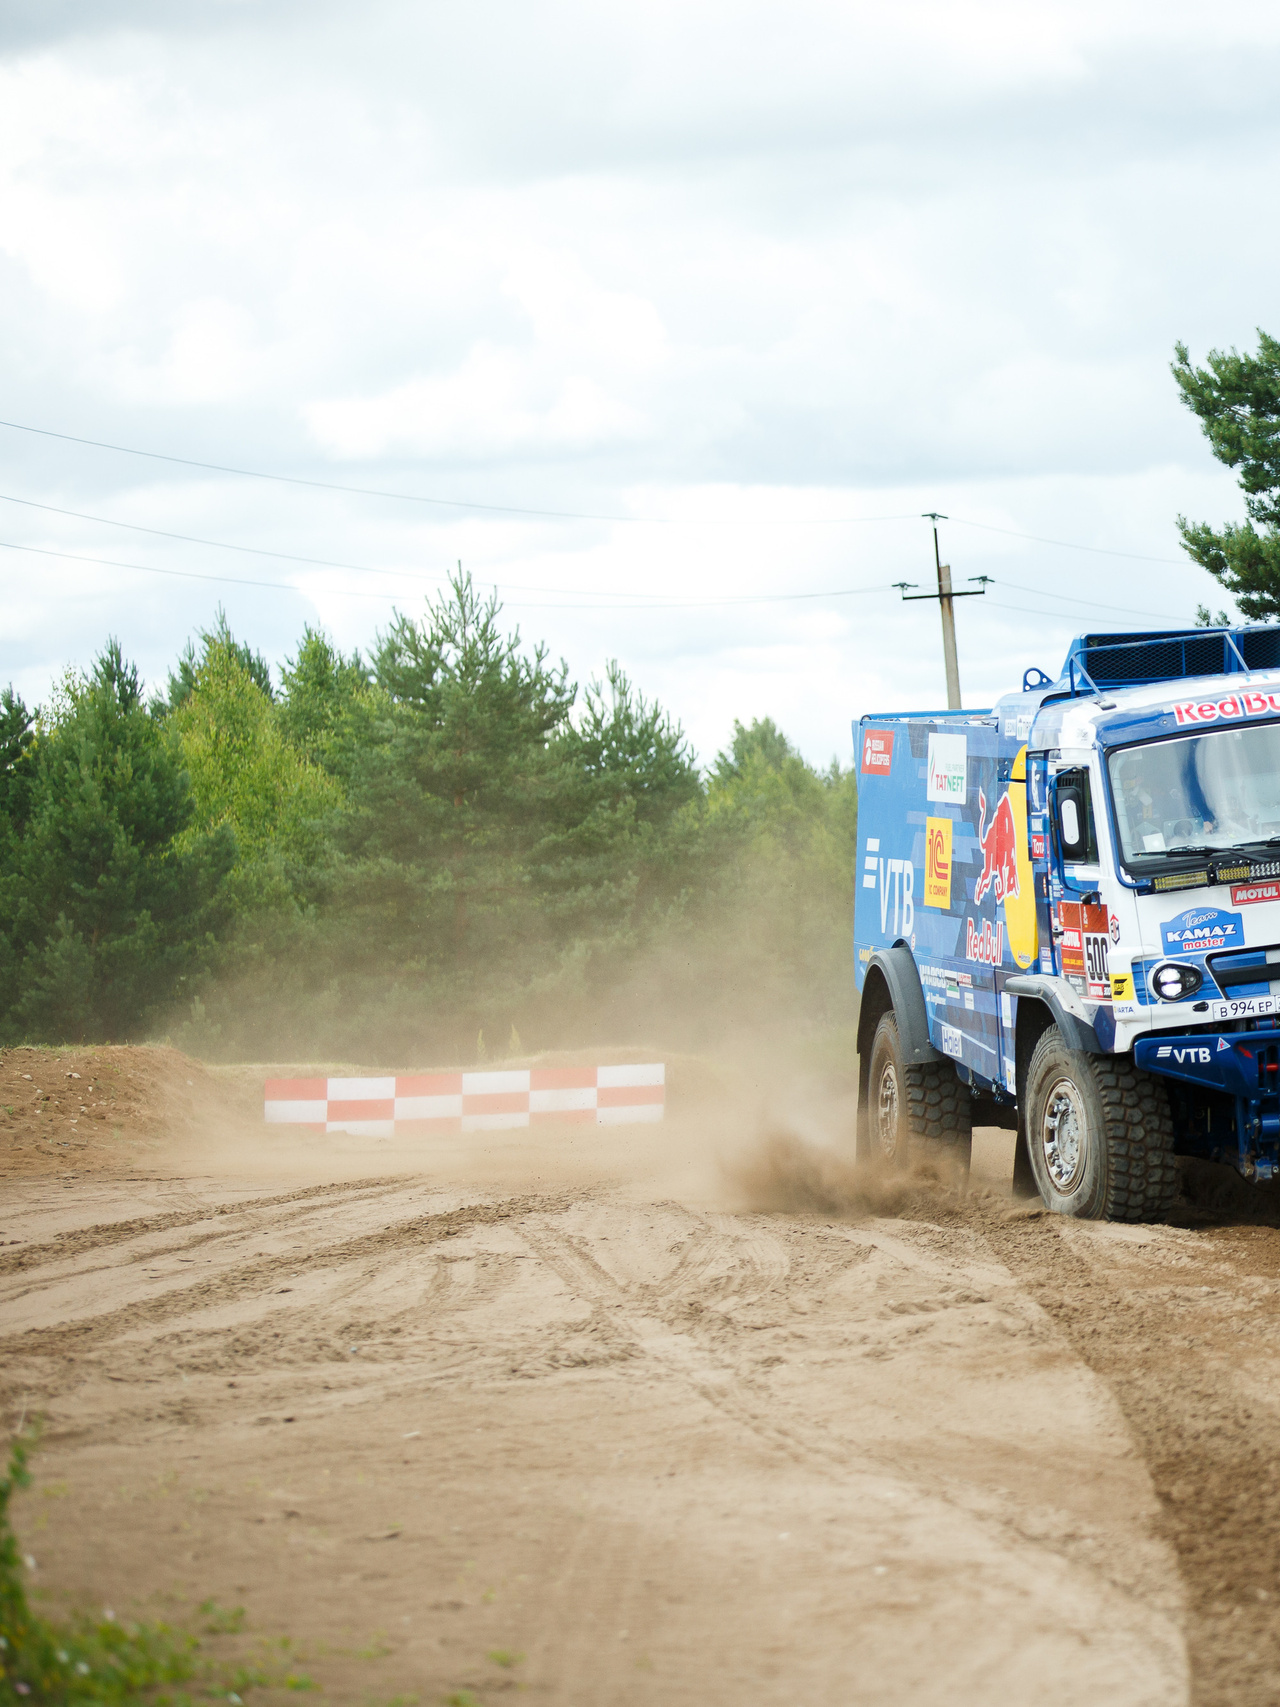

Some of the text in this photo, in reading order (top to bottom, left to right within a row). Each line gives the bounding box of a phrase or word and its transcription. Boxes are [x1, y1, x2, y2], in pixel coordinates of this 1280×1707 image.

[1172, 695, 1242, 725] Red
[936, 774, 964, 792] TATNEFT
[879, 857, 914, 937] VTB
[1235, 886, 1279, 901] MOTUL
[1182, 910, 1218, 928] Team
[966, 917, 1003, 966] Red Bull
[1166, 923, 1237, 942] KAMAZ
[1183, 937, 1225, 951] master
[1085, 936, 1110, 981] 500
[943, 1029, 961, 1055] Haier
[1173, 1047, 1212, 1064] VTB
